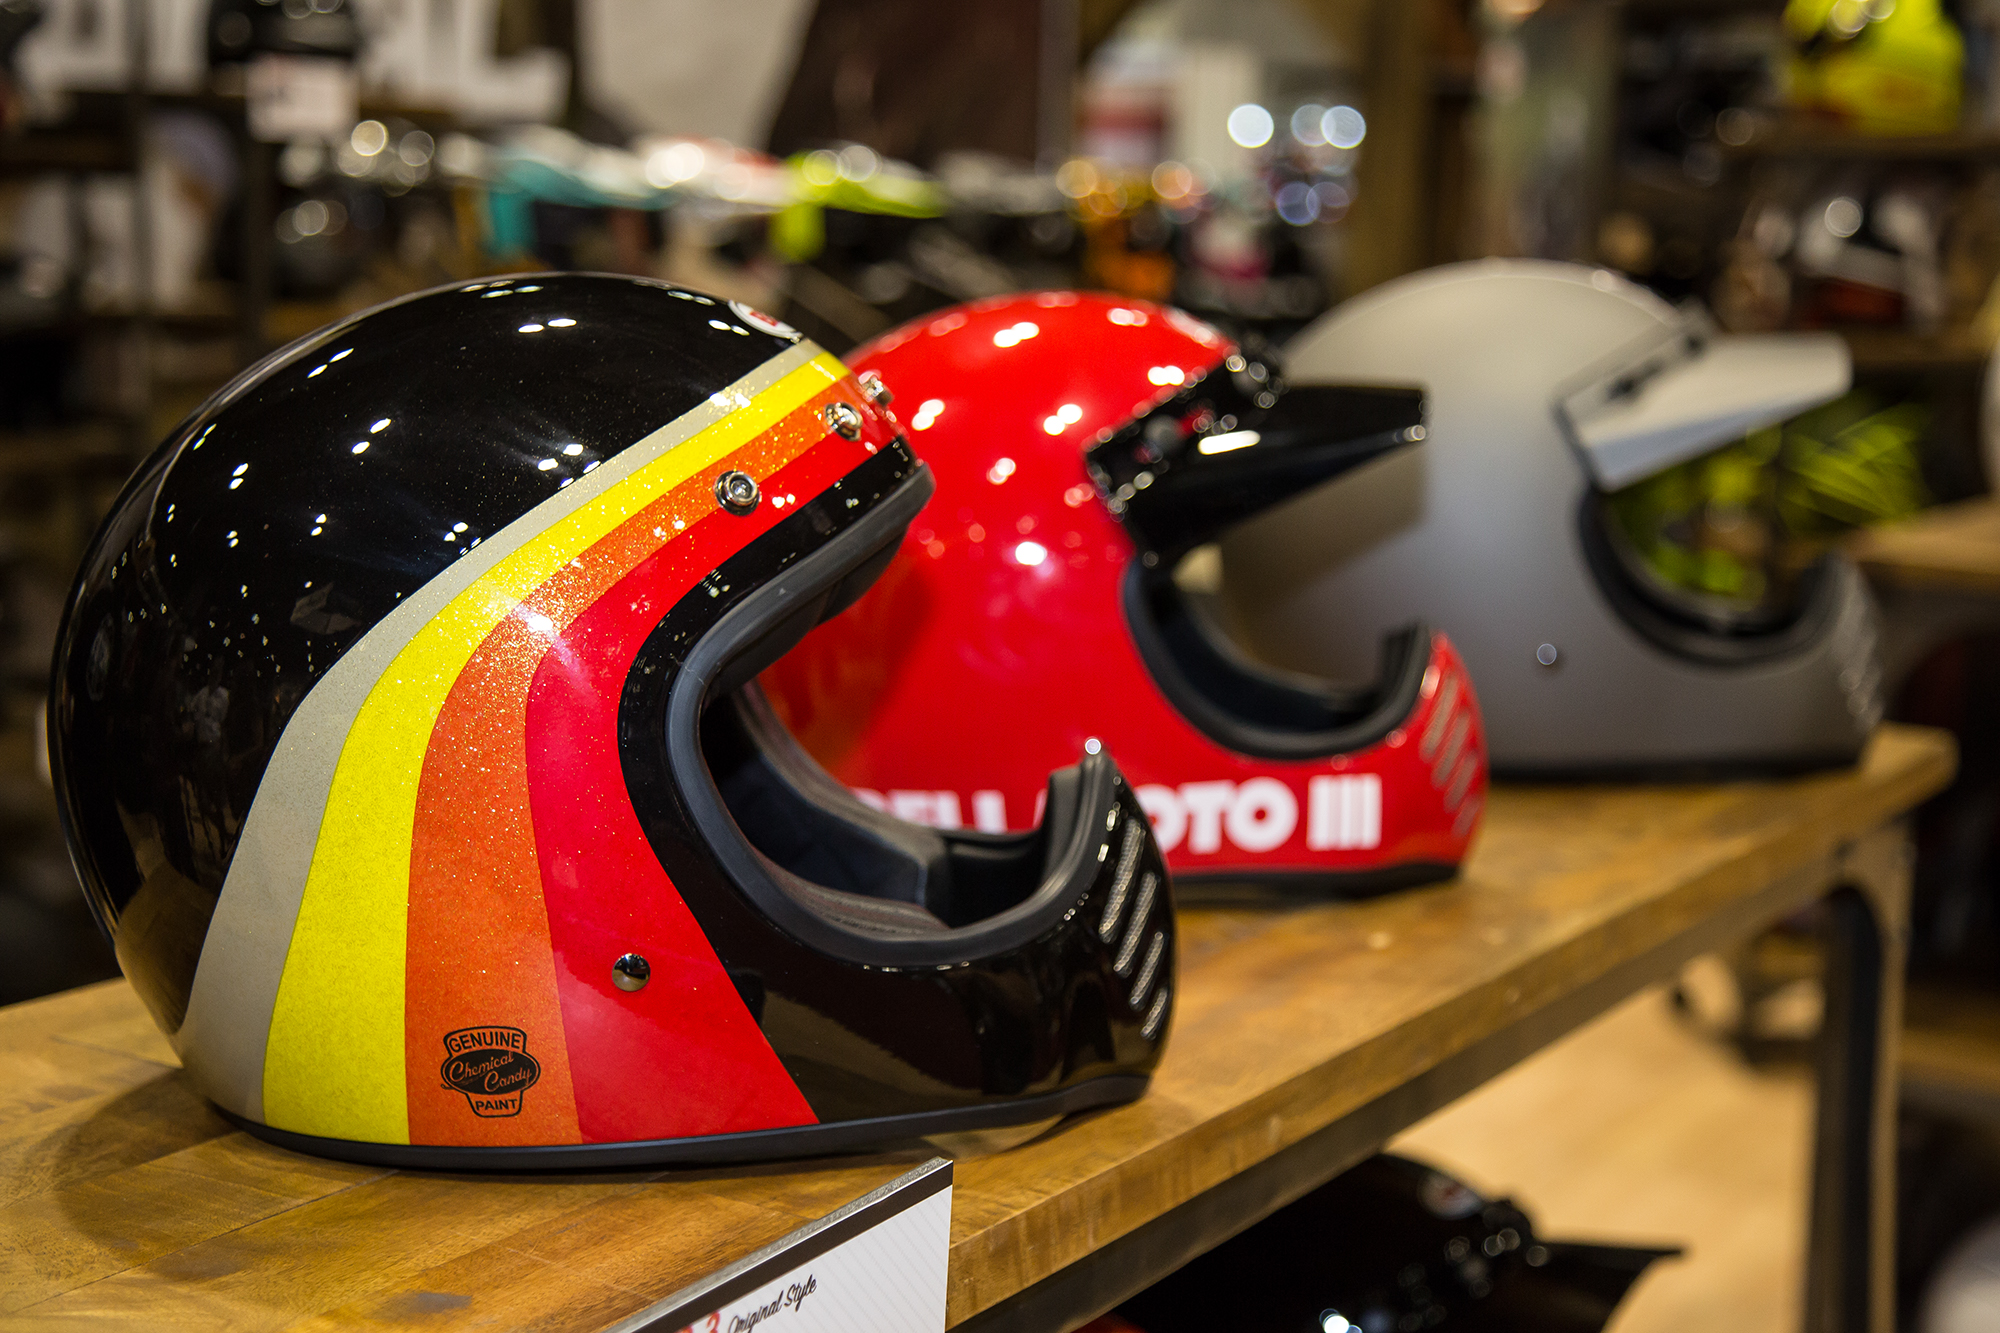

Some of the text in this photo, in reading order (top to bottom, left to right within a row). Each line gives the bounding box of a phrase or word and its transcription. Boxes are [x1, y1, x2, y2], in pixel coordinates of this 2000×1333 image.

[1032, 776, 1299, 855] OTO
[448, 1031, 522, 1053] GENUINE
[449, 1050, 515, 1082] Chemical
[484, 1067, 532, 1092] Candy
[475, 1099, 518, 1111] PAINT
[728, 1290, 784, 1333] Original
[784, 1274, 817, 1313] Style
